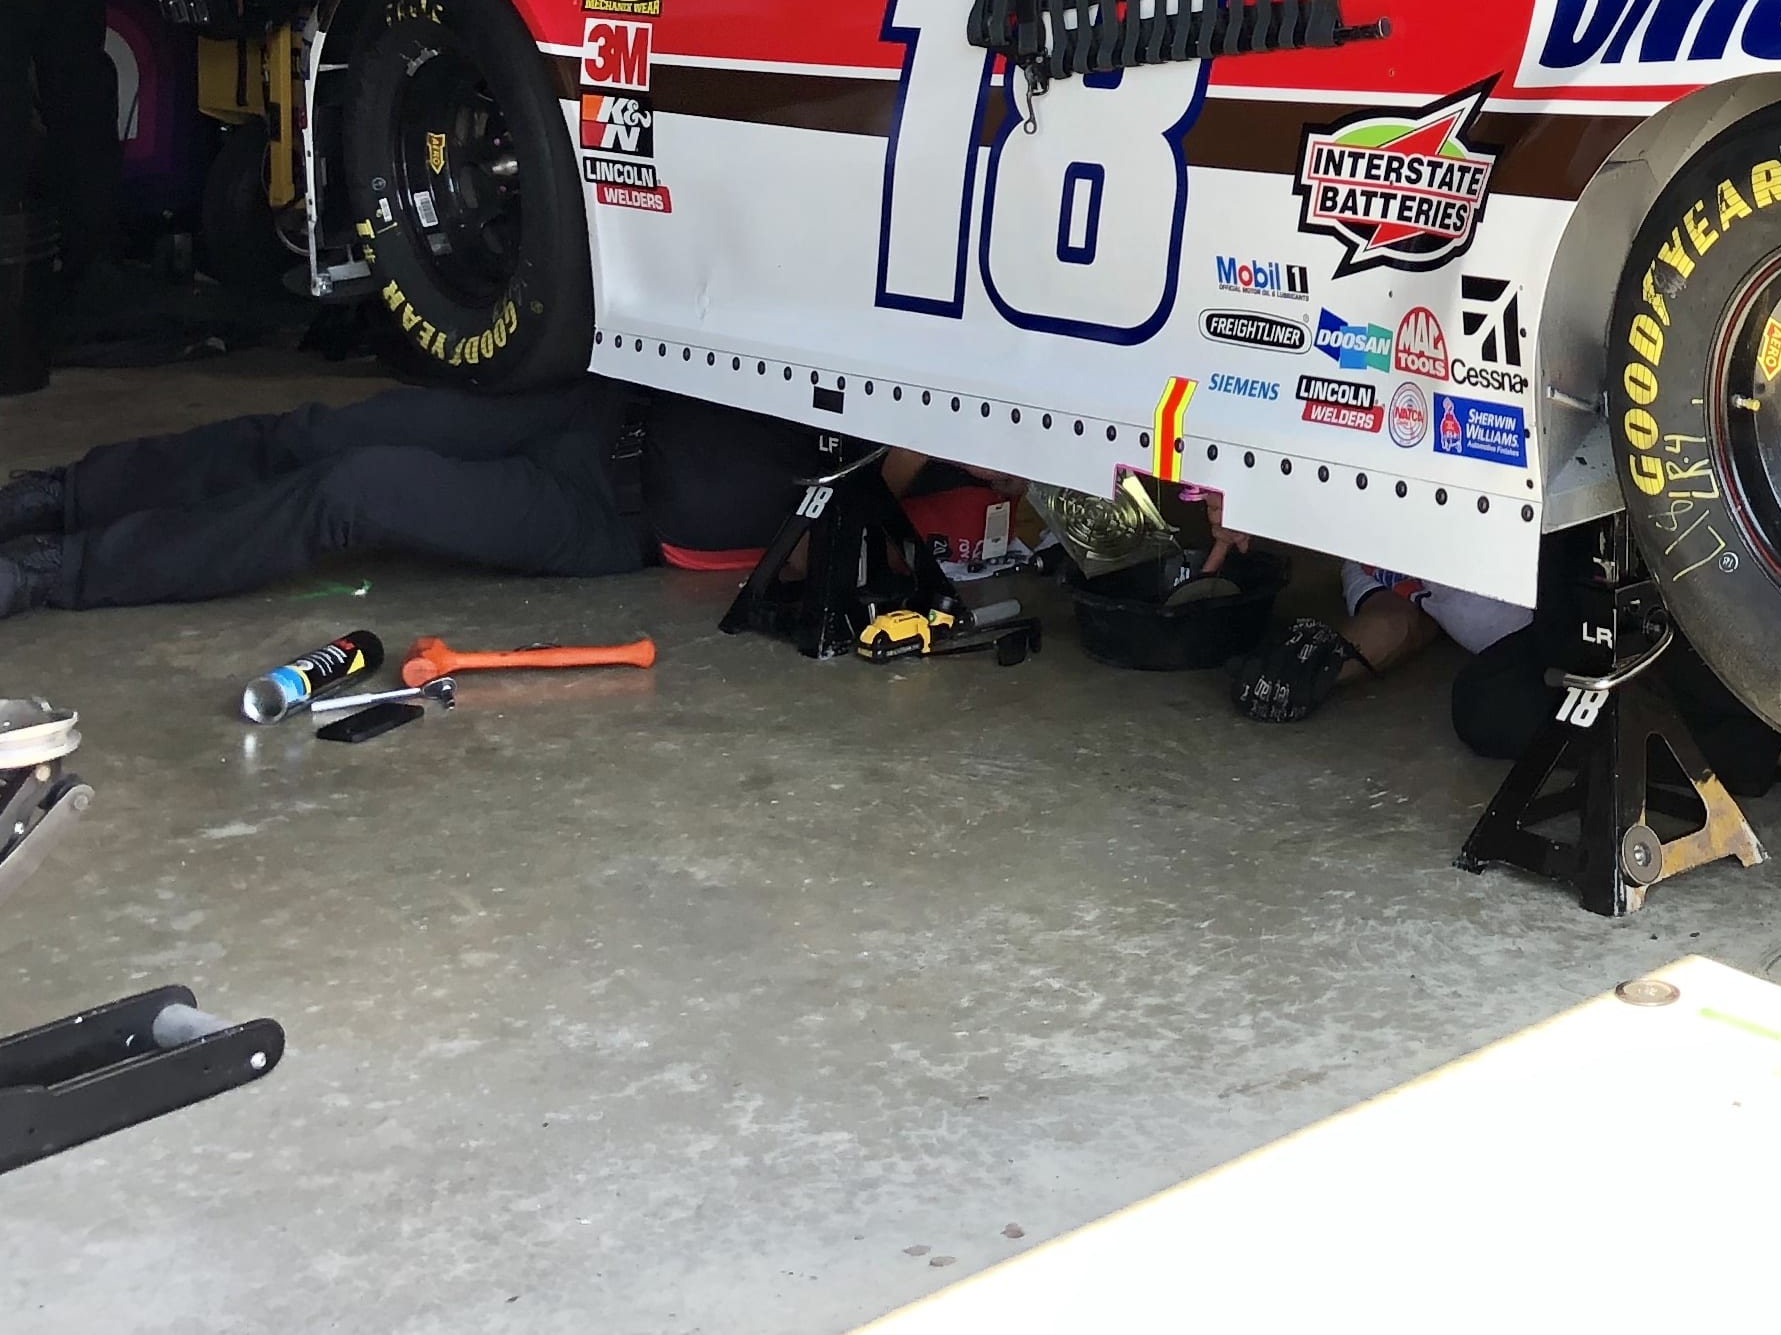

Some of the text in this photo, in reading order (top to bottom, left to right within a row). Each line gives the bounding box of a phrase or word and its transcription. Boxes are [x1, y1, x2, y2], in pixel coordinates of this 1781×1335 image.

[633, 0, 660, 15] WEAR
[585, 23, 650, 86] 3M
[585, 160, 654, 187] LINCOLN
[1313, 147, 1484, 197] INTERSTATE
[604, 187, 664, 210] WELDERS
[1318, 187, 1469, 234] BATTERIES
[1216, 255, 1309, 294] Mobil 1
[1219, 284, 1241, 293] OFFICIAL
[1242, 287, 1261, 296] MOTOR
[382, 278, 518, 367] GOODYEAR
[1210, 317, 1301, 346] FREIGHTLINER
[1398, 311, 1446, 360] MAC
[1317, 328, 1391, 355] DOOSAN
[1398, 352, 1446, 377] TOOLS
[1451, 358, 1525, 395] Cessna
[1208, 373, 1280, 401] SIEMENS
[1299, 380, 1373, 408] LINCOLN
[1310, 405, 1375, 430] WELDERS
[1395, 407, 1424, 424] NATCA
[1469, 408, 1517, 431] SHERWIN
[819, 435, 839, 454] LF
[1466, 423, 1519, 448] WILLIAMS
[1467, 441, 1520, 457] Automotive Finishes
[796, 486, 834, 519] 18
[1582, 621, 1613, 650] LR
[1555, 686, 1610, 728] 18
